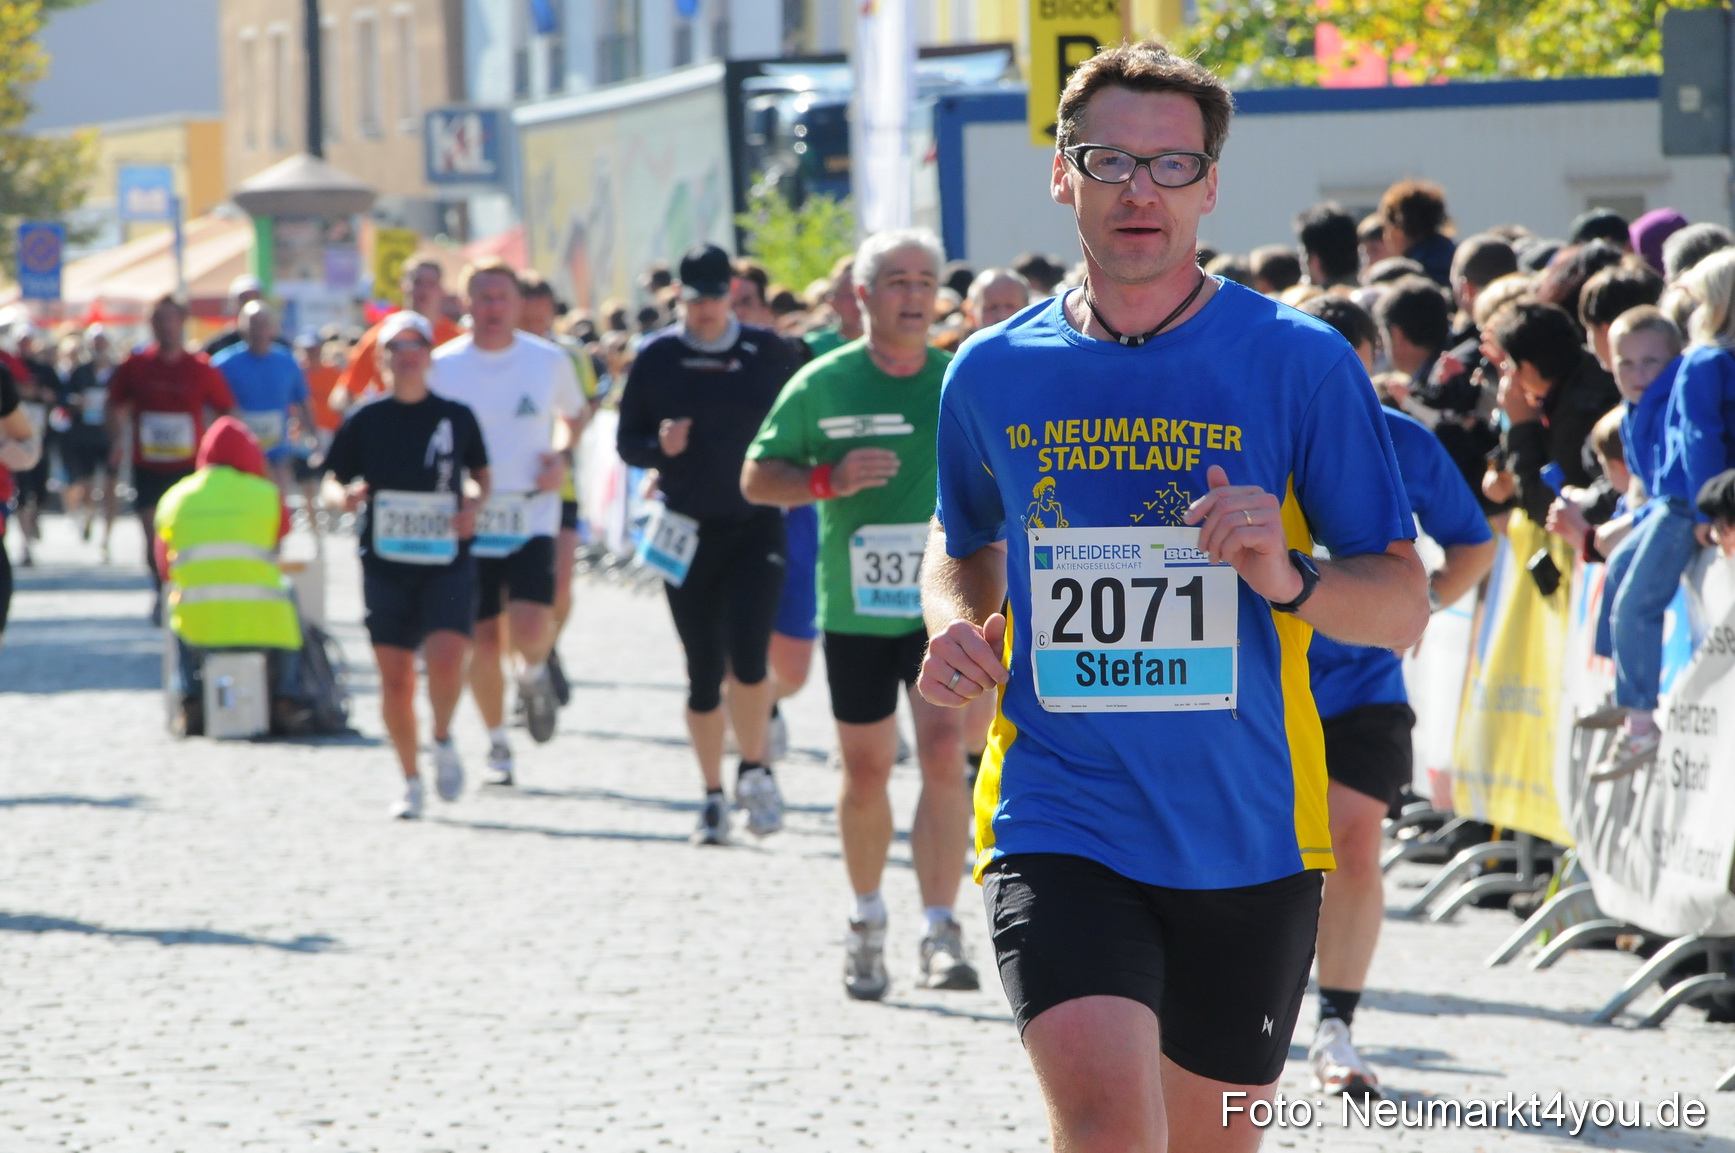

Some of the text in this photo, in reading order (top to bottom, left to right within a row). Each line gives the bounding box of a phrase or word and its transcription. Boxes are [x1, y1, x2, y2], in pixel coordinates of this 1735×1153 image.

[1039, 0, 1119, 20] Block
[1006, 417, 1243, 452] 10. NEUMARKTER
[1038, 445, 1201, 472] STADTLAUF
[1055, 544, 1142, 560] PFLEIDERER
[1055, 562, 1143, 570] AKTIENGESELLSCHAFT
[1051, 575, 1204, 644] 2071
[1075, 650, 1188, 687] Stefan
